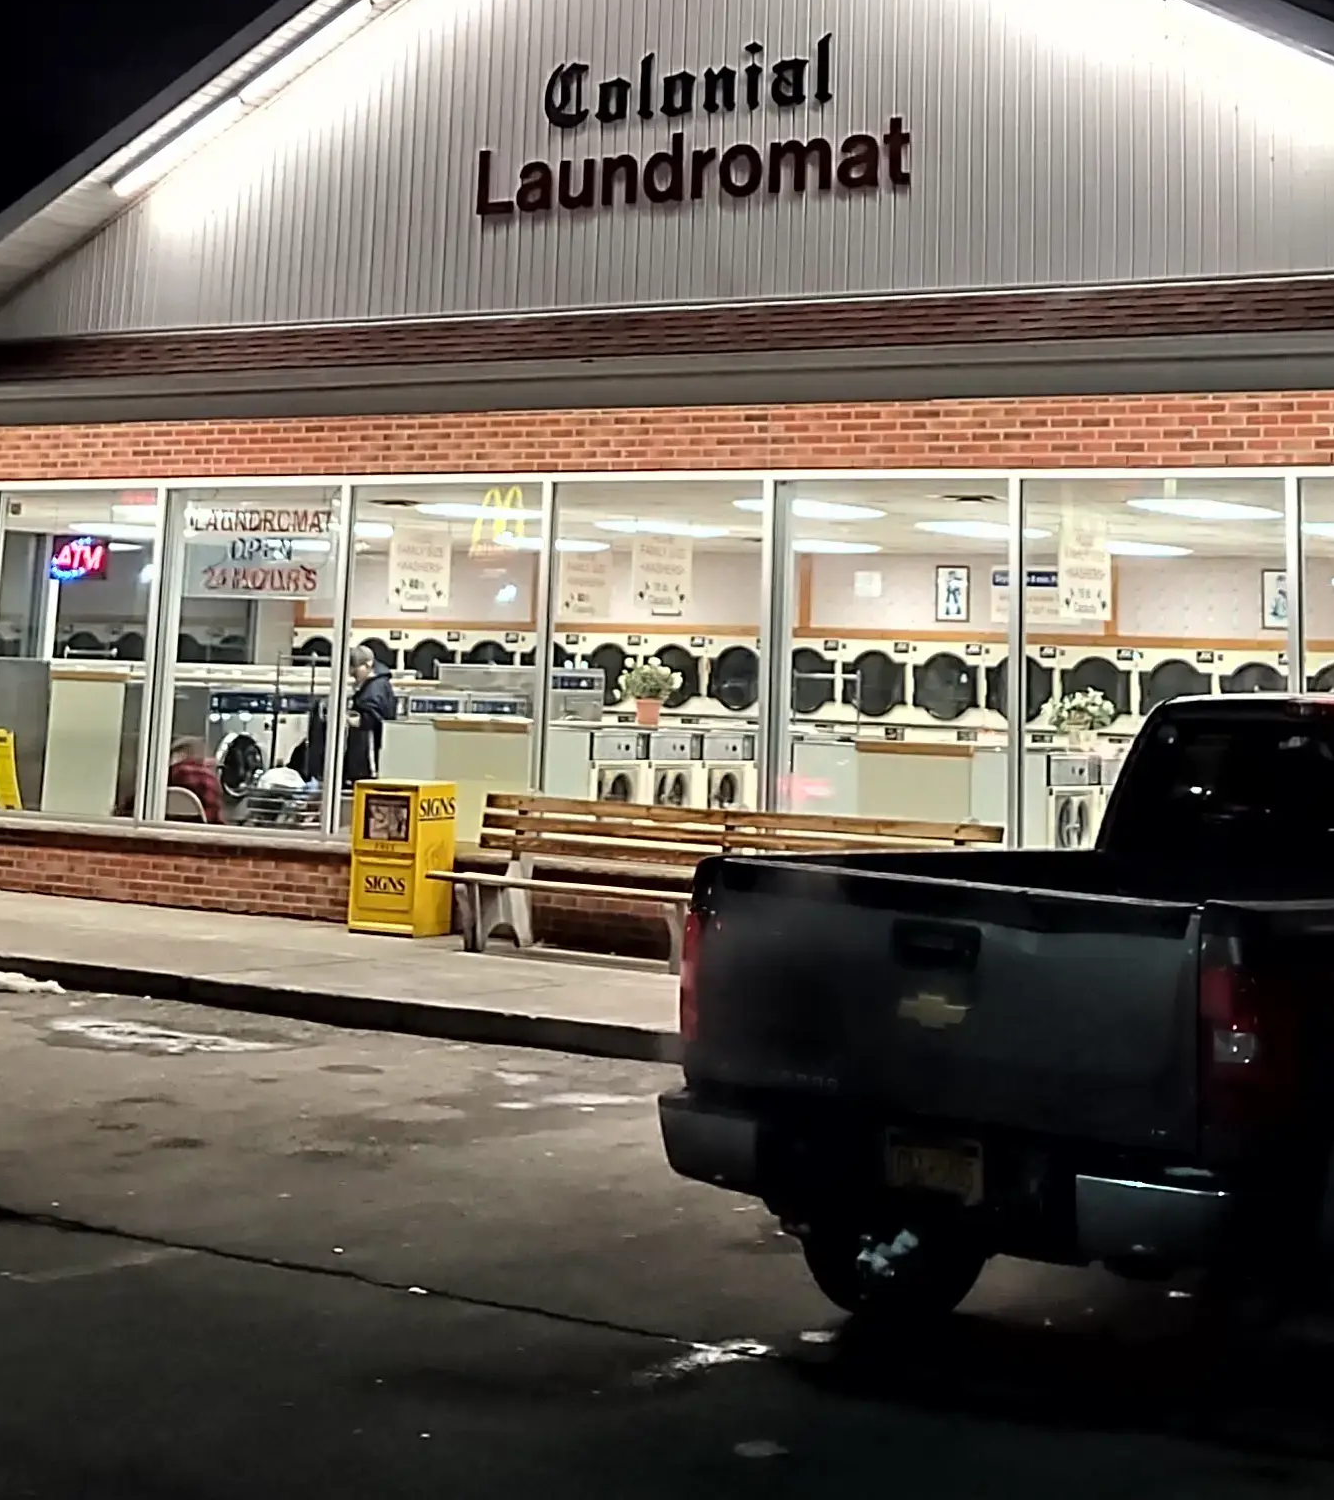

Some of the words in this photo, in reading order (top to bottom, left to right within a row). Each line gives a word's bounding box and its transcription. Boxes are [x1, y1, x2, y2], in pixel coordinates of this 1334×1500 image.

[544, 33, 834, 129] Colonial
[475, 116, 911, 216] Laundromat
[56, 544, 104, 571] ATM
[419, 797, 456, 818] SIGNS
[364, 874, 406, 893] SIGNS
